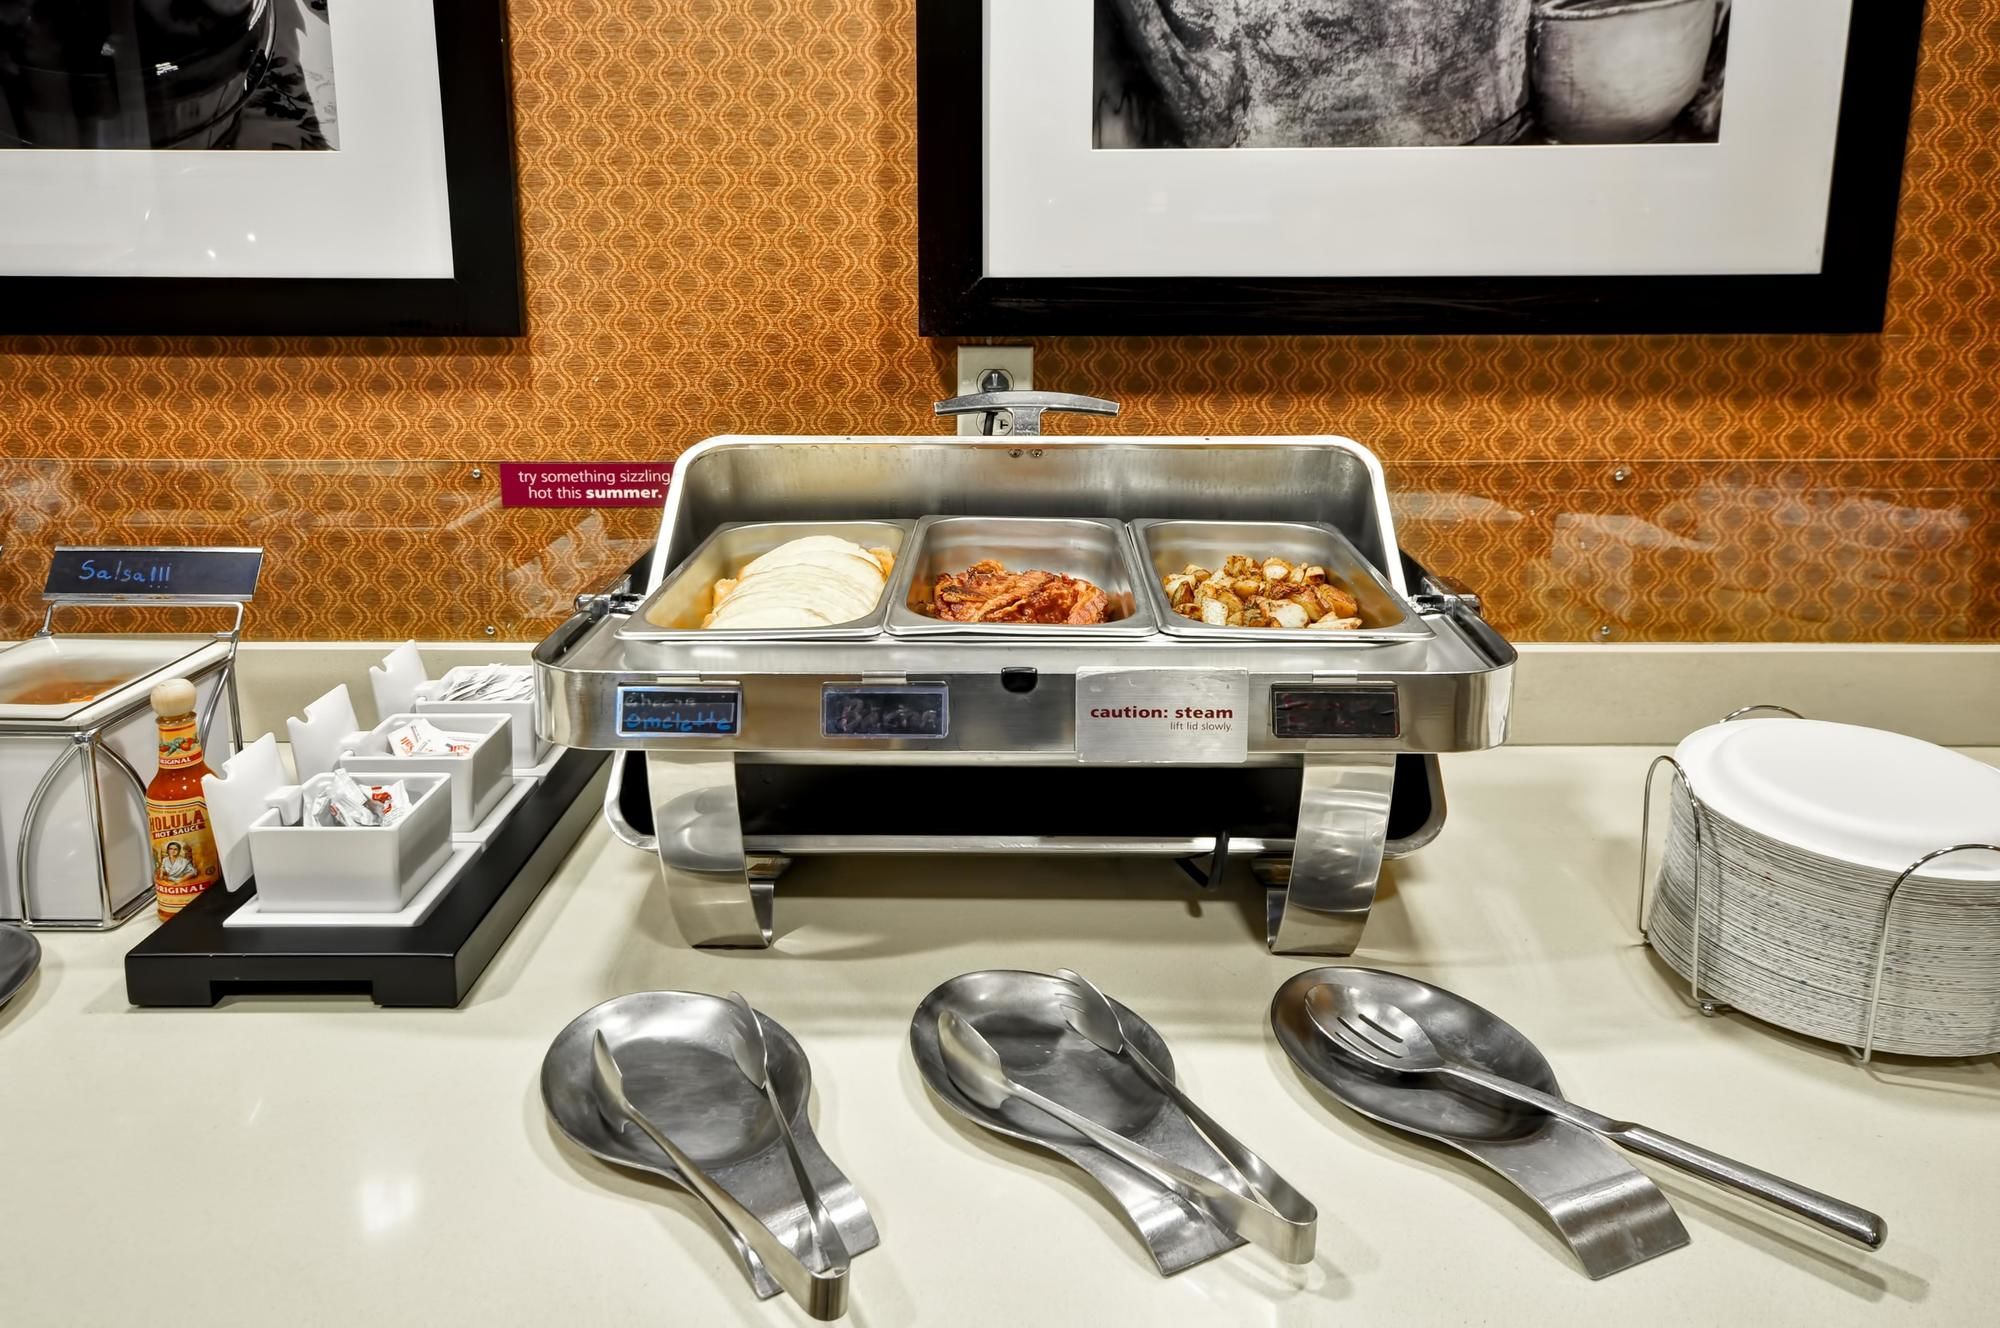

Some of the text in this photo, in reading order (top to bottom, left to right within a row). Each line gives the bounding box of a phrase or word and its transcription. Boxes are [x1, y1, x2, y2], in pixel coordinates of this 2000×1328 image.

[518, 470, 671, 485] try something sizzling
[528, 486, 663, 499] hot this summer.
[1090, 705, 1233, 719] caution: steam
[1170, 721, 1233, 732] lift lid slowly.
[155, 825, 200, 839] HOT SAUCE
